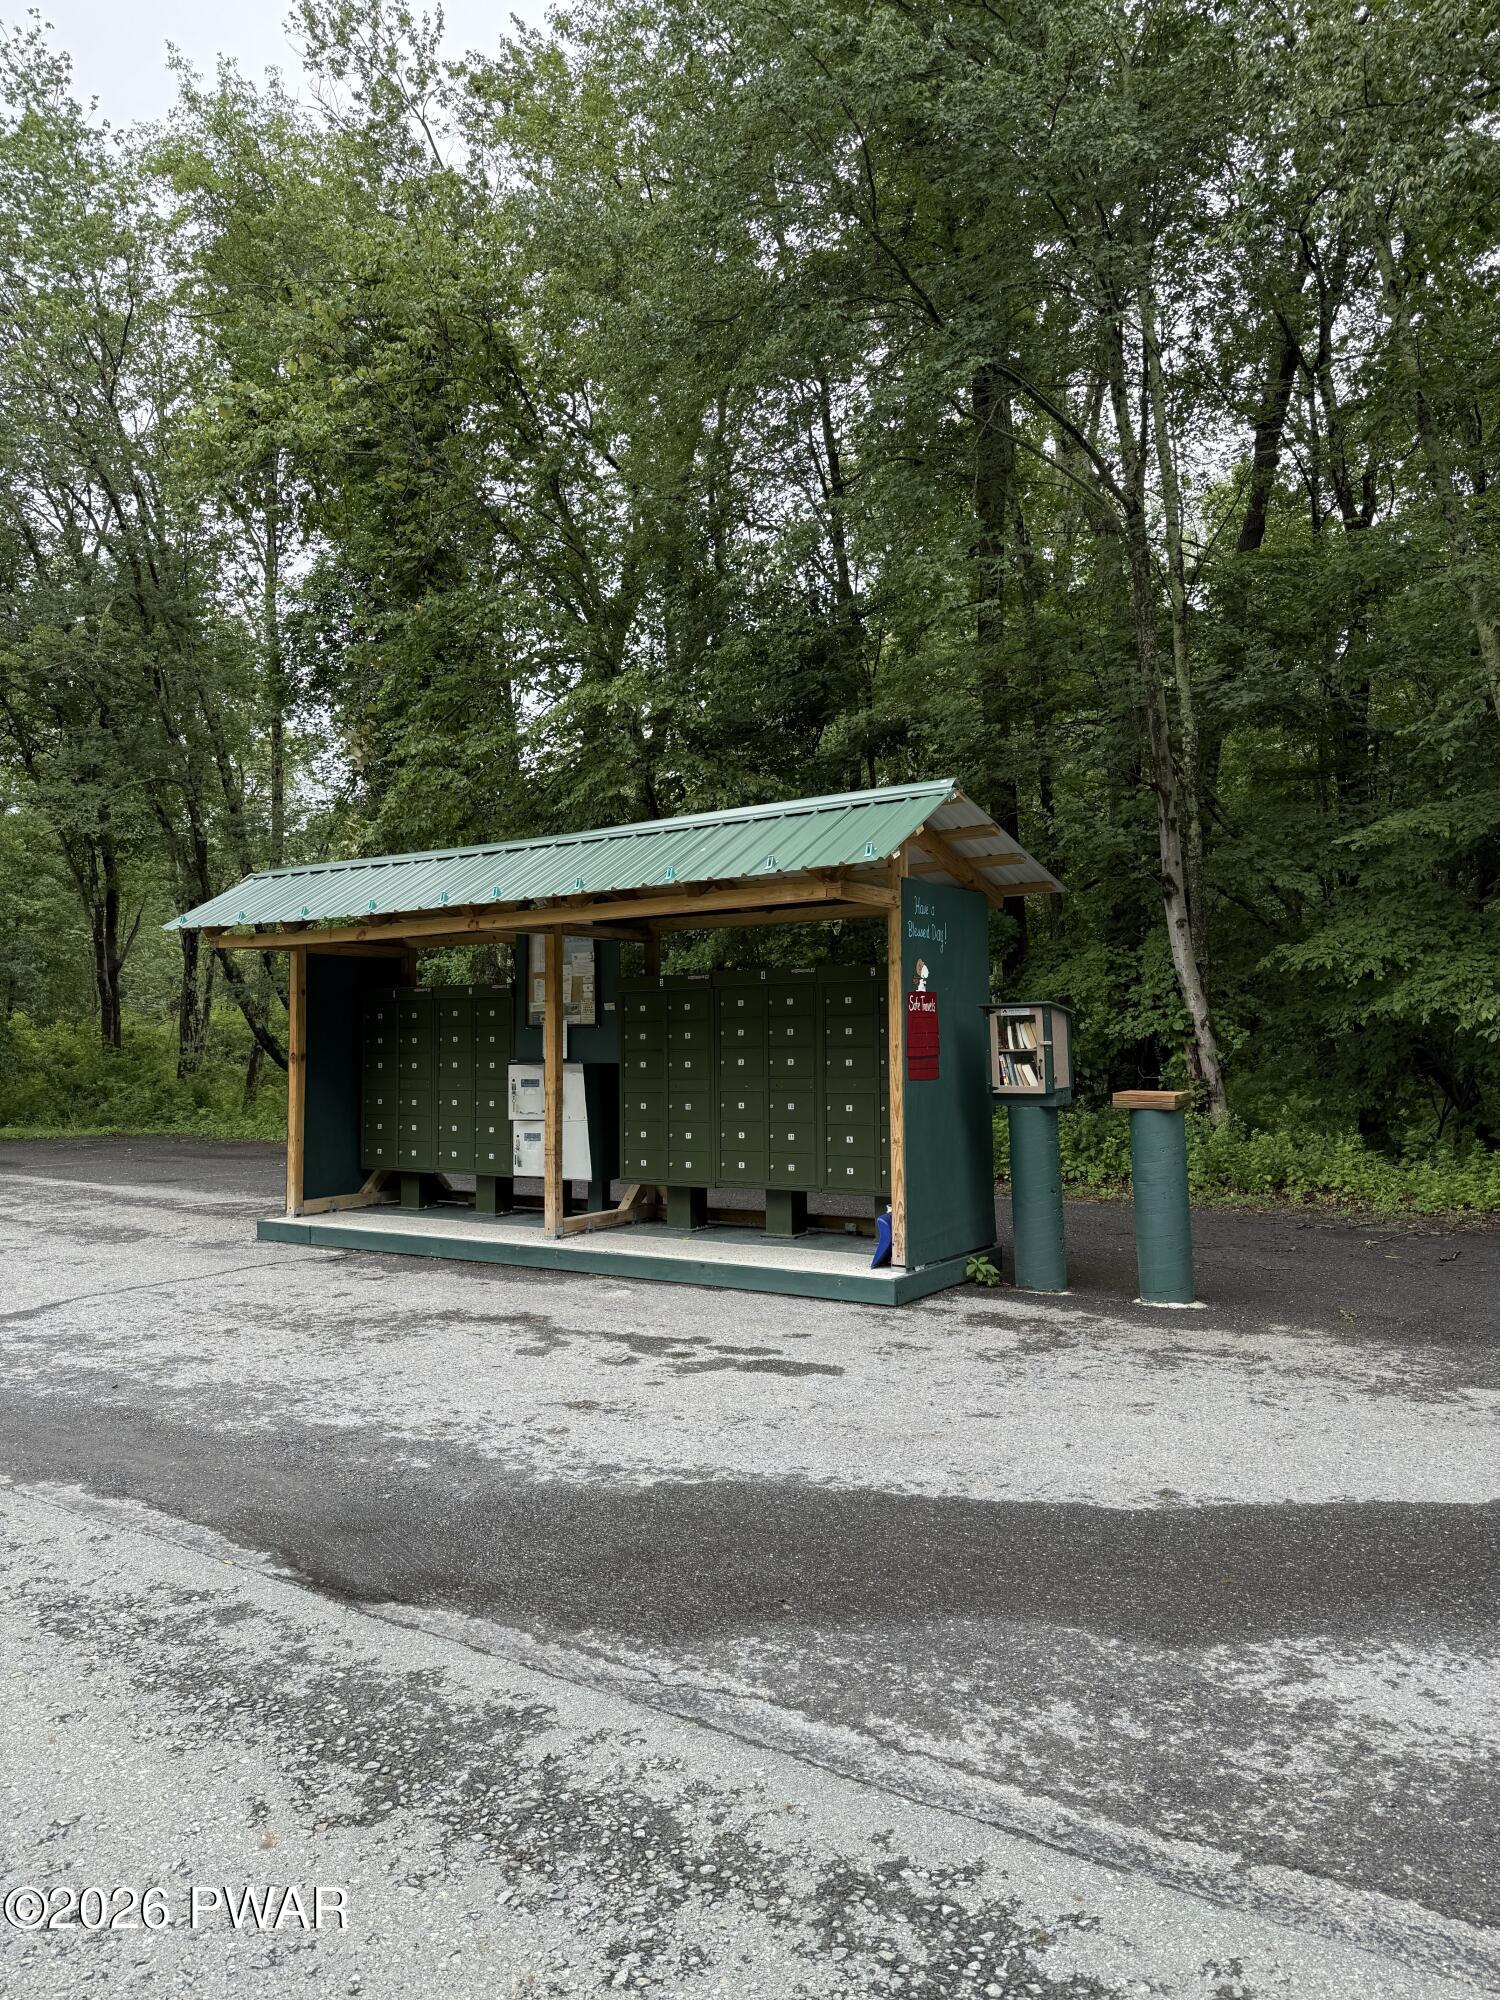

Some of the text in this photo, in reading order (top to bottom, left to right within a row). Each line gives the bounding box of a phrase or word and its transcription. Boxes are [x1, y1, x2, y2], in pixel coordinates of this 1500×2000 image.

[914, 895, 929, 915] Have
[907, 920, 947, 954] Blessed Day!
[908, 994, 936, 1013] Safe Travels
